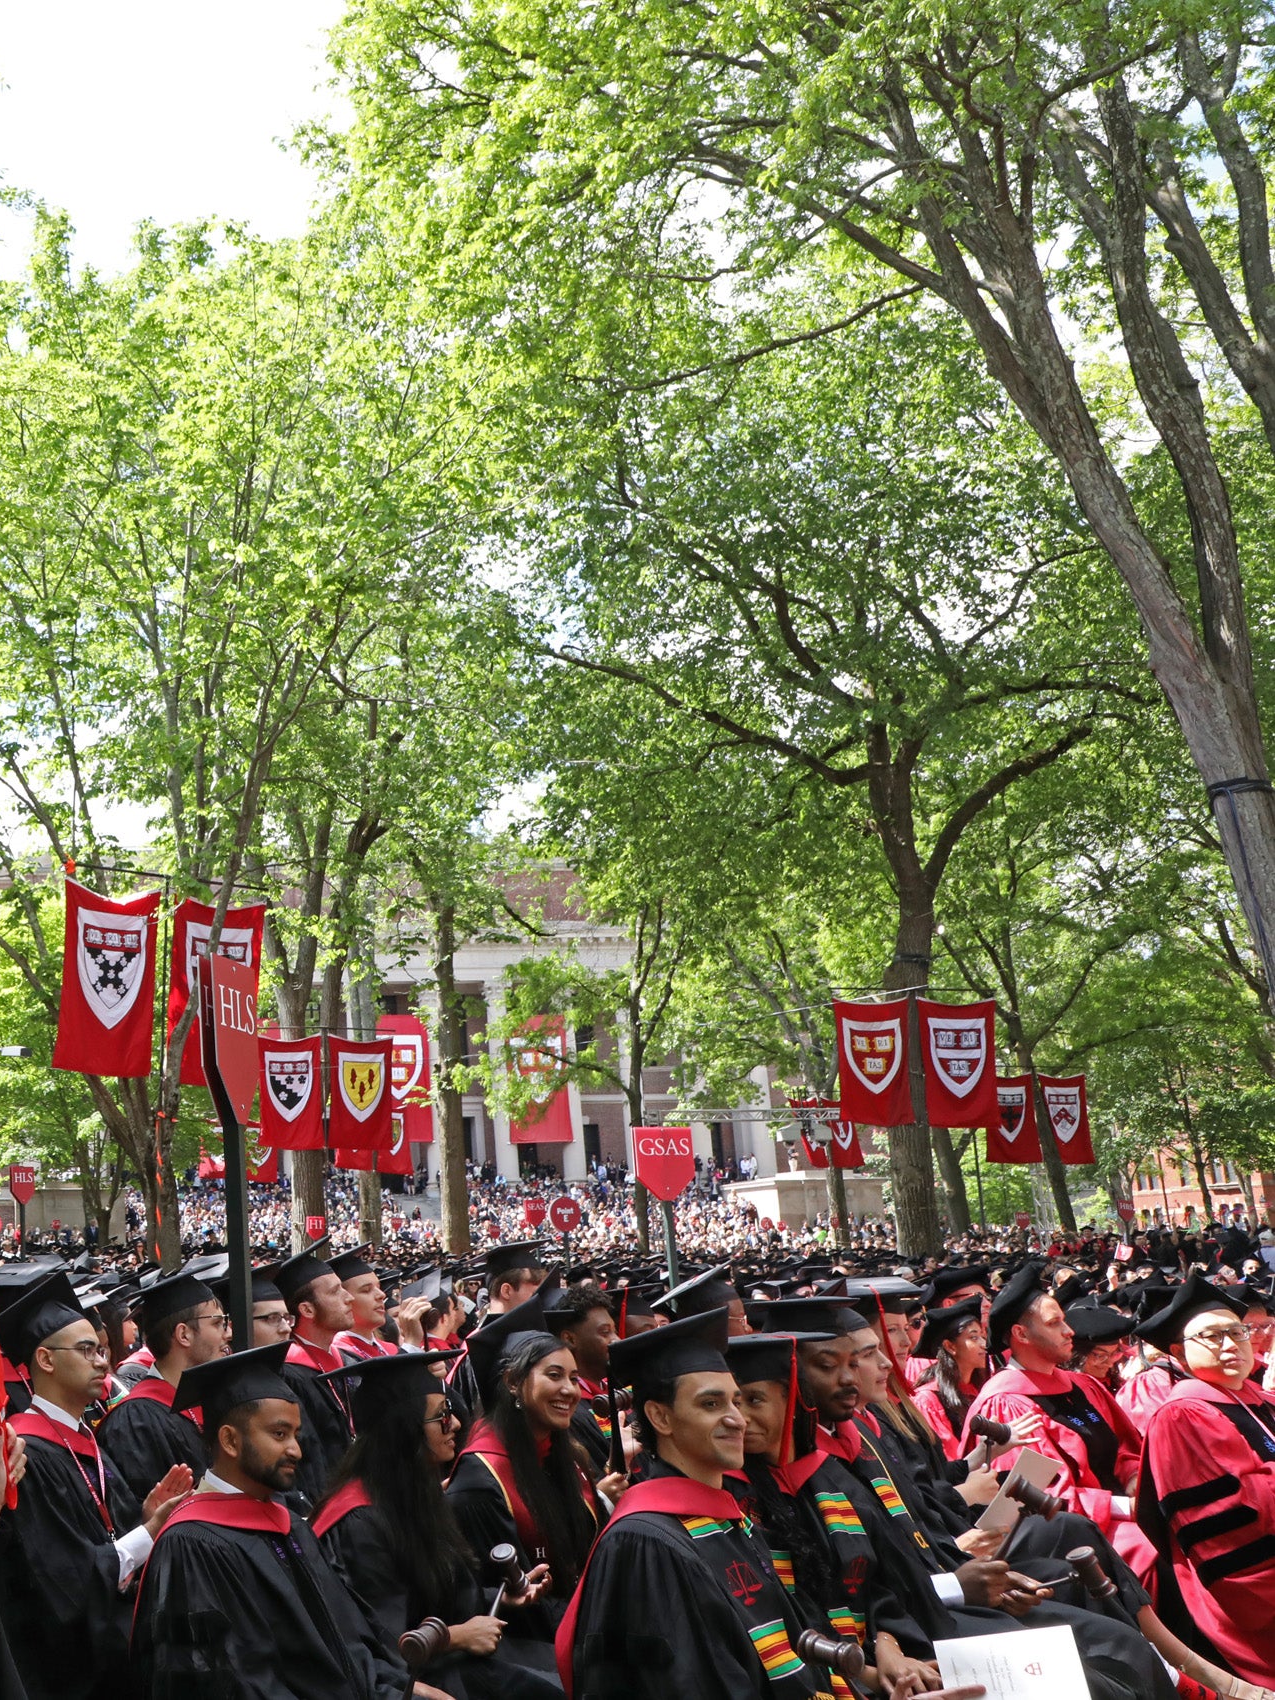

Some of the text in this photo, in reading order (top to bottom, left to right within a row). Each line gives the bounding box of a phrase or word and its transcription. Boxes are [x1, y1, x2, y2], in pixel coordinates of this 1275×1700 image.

[218, 984, 255, 1035] HLS
[940, 1034, 974, 1042] VE RI
[856, 1039, 888, 1047] VE RI
[868, 1061, 882, 1069] TAS
[952, 1063, 966, 1071] TAS
[638, 1138, 690, 1156] GSAS
[14, 1172, 33, 1183] HLS
[527, 1203, 544, 1211] SEAS
[556, 1207, 574, 1215] Point
[309, 1219, 324, 1230] H1
[535, 1546, 546, 1559] H
